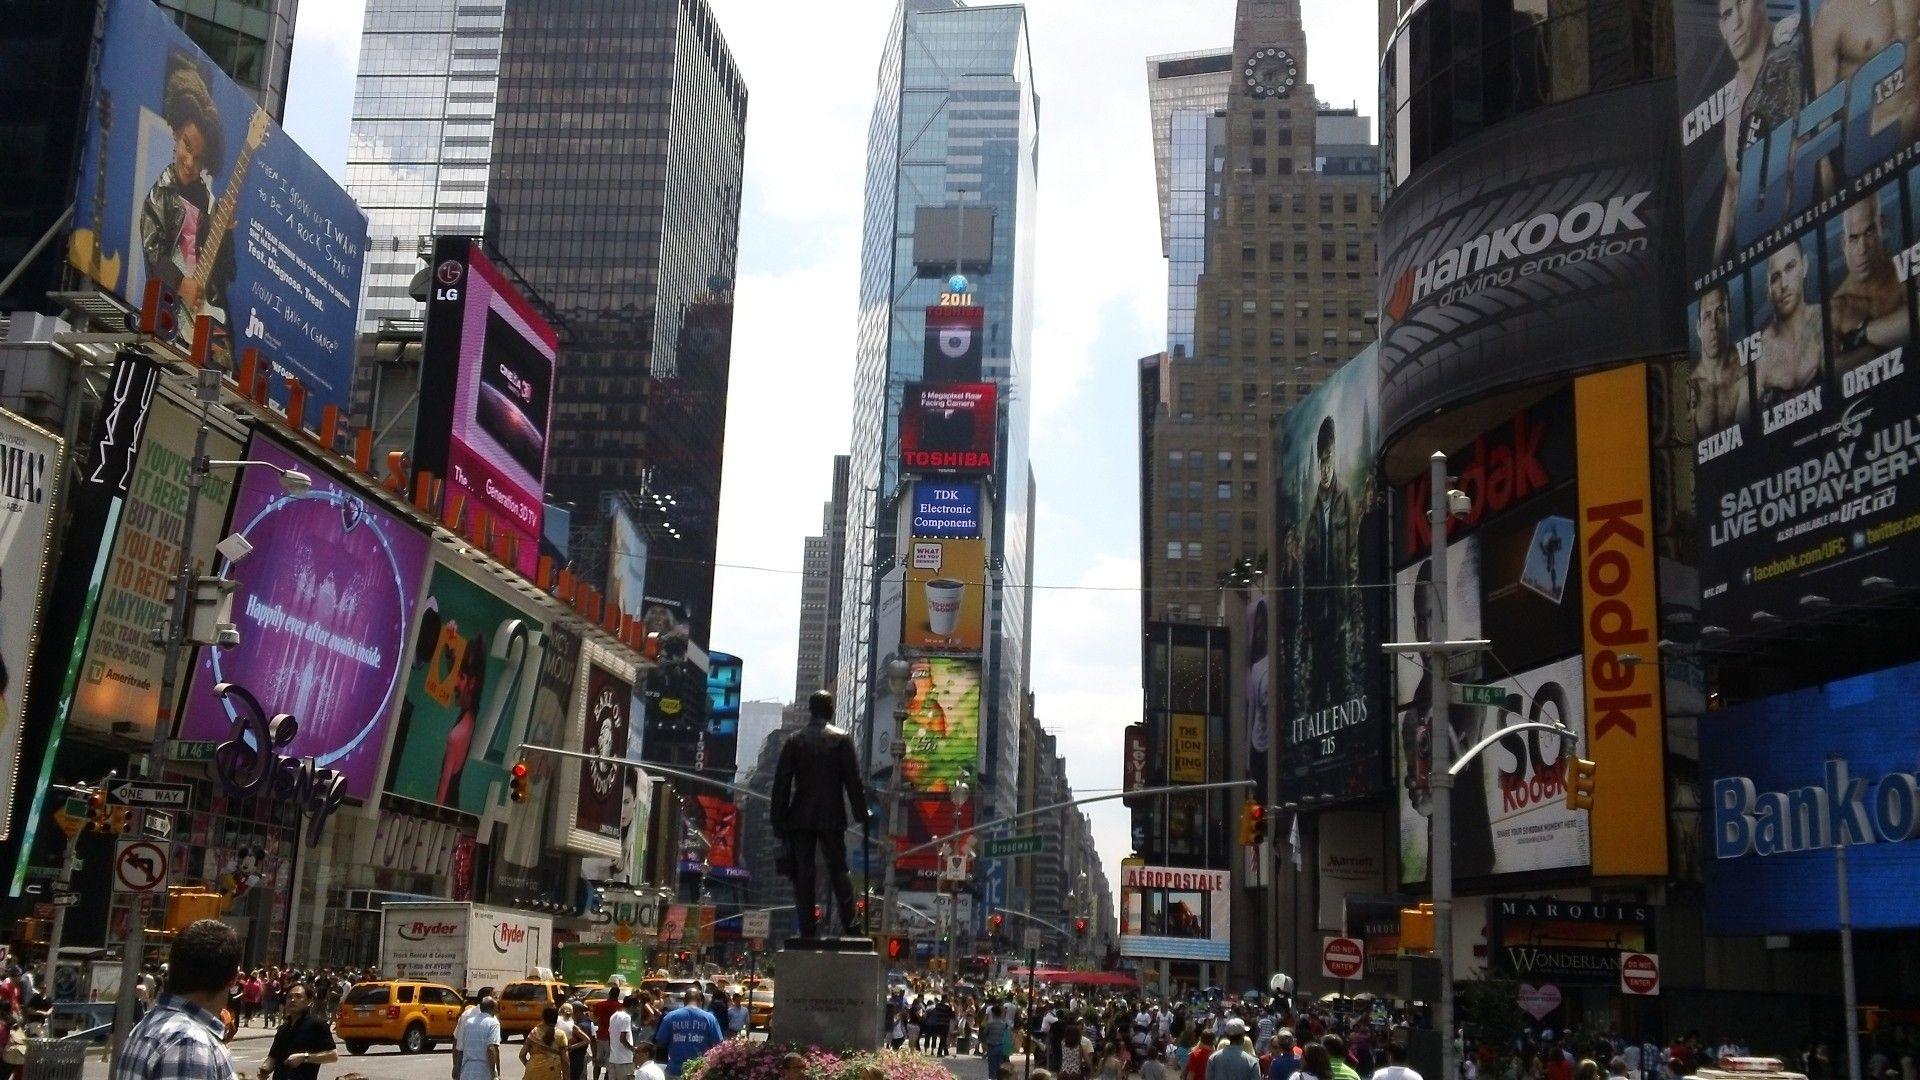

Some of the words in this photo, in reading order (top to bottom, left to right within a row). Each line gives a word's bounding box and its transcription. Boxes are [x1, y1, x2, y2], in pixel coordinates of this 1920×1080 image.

[1694, 261, 1734, 291] WORLD
[1740, 188, 1848, 263] BANTAMWEIGHT
[1439, 263, 1514, 308] driving
[1519, 236, 1648, 277] emotion
[436, 288, 458, 301] LG
[940, 293, 972, 306] 2011
[1736, 331, 1764, 367] VS
[1842, 346, 1905, 399] ORTIZ
[921, 399, 946, 408] Facing
[1762, 385, 1823, 436] LEBEN
[1698, 424, 1744, 464] SILVA
[903, 451, 992, 466] TOSHIBA
[1720, 442, 1856, 519] SATURDAY
[486, 478, 519, 516] Generation
[933, 489, 959, 500] TDK
[126, 496, 158, 533] BUT
[920, 503, 972, 514] Electronic
[914, 517, 977, 529] Components
[1711, 508, 1758, 548] LIVE
[1760, 493, 1797, 529] ON
[120, 526, 152, 563] YOU
[245, 593, 286, 633] Happily
[285, 615, 307, 637] ever
[304, 621, 331, 647] after
[328, 634, 358, 659] awaits
[1586, 498, 1652, 741] Kodak
[105, 668, 151, 692] Ameritrade
[1477, 687, 1491, 703] 46
[1292, 717, 1306, 745] IT
[1308, 709, 1330, 739] ALL
[1331, 694, 1368, 735] ENDS
[1179, 726, 1198, 737] THE
[180, 743, 189, 757] W
[190, 743, 203, 758] 46
[1175, 738, 1201, 754] LION
[1175, 757, 1201, 773] KING
[119, 788, 144, 800] ONE
[154, 790, 179, 801] WAY
[992, 841, 1034, 855] Broadway
[1502, 902, 1646, 920] MARQUIS
[411, 921, 458, 938] Ryder
[501, 922, 526, 947] Ryder
[1330, 944, 1341, 952] DO
[1342, 945, 1356, 954] NOT
[1331, 961, 1355, 971] ENTER
[1630, 978, 1652, 988] ENTER
